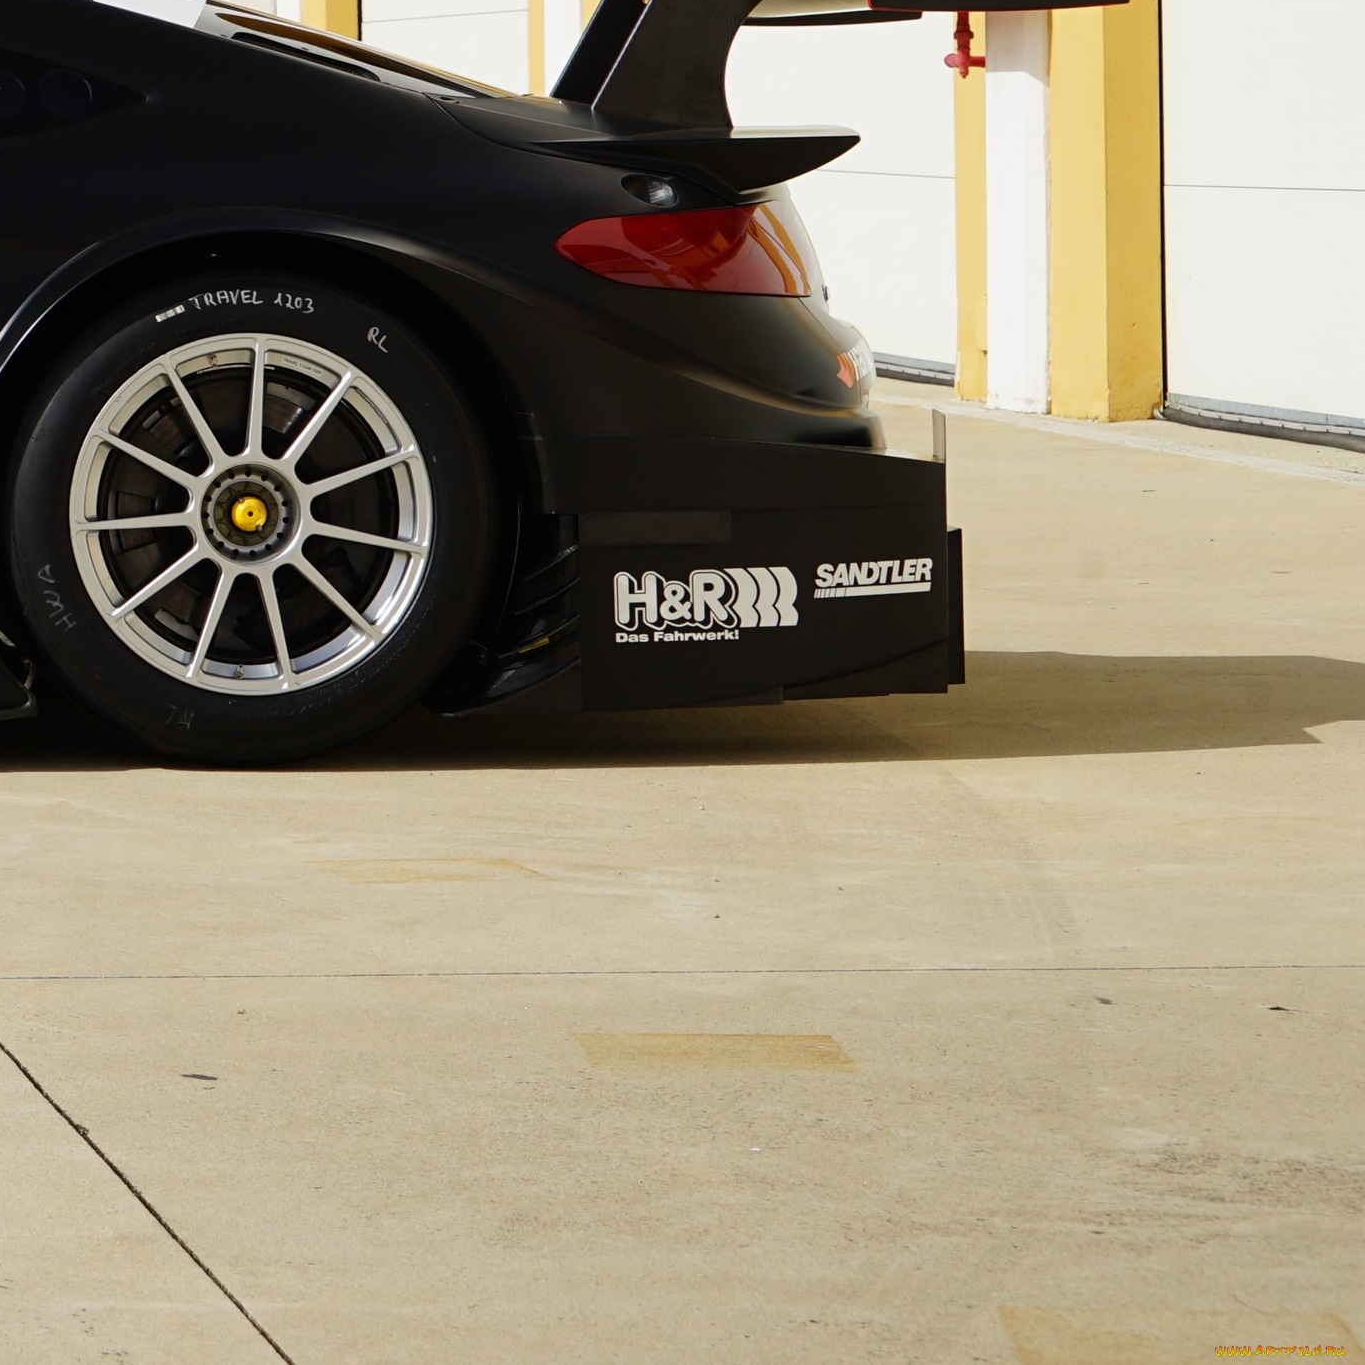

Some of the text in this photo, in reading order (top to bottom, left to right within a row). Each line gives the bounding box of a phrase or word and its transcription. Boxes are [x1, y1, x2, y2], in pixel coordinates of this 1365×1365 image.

[188, 289, 315, 313] TRAVEL 1203
[367, 326, 389, 353] RL
[815, 558, 933, 588] SANDTLER
[614, 569, 741, 631] H&R
[615, 630, 740, 644] Das Fahrwerk!
